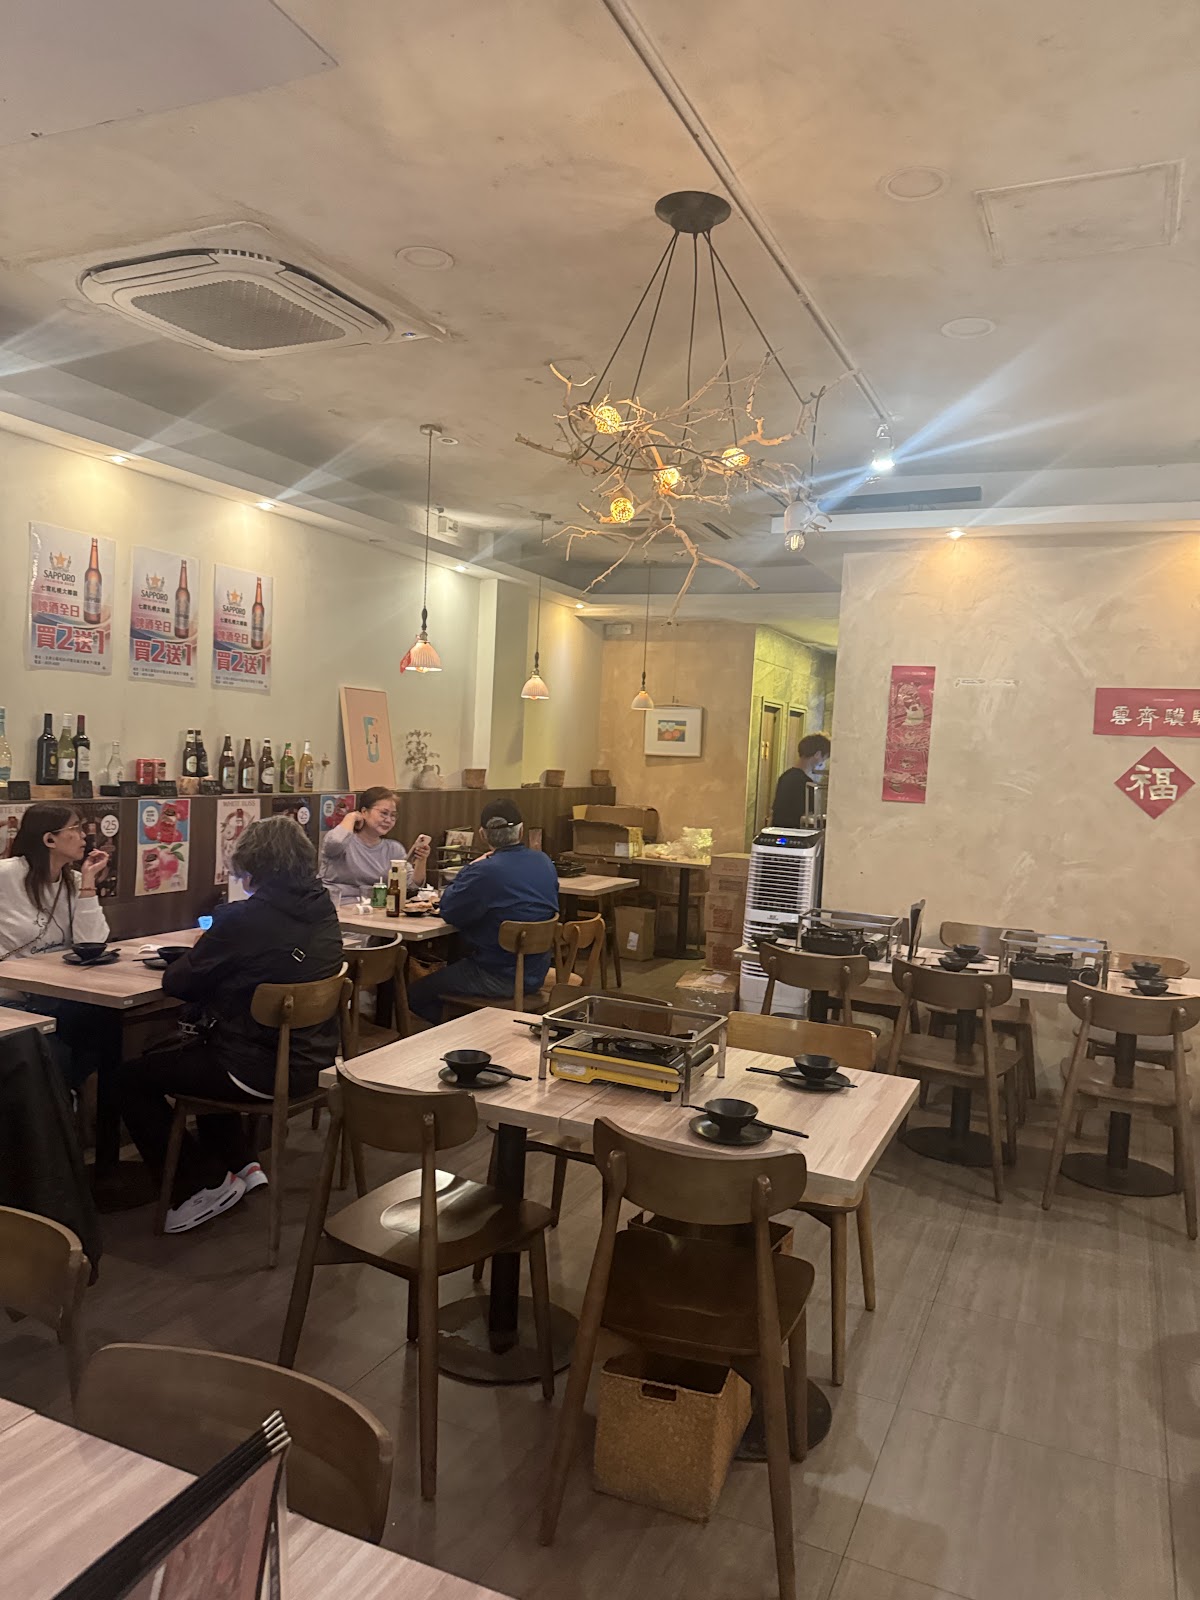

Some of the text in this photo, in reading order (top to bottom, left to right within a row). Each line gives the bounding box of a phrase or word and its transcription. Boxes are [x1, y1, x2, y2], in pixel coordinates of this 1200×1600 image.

[44, 570, 75, 582] SAPPORO
[141, 590, 168, 601] SAPPORO
[222, 605, 246, 615] SAPPORO
[37, 625, 104, 654] 買2送1
[135, 640, 192, 666] 買2送1
[217, 651, 266, 675] 買2送1
[1125, 764, 1178, 801] 福
